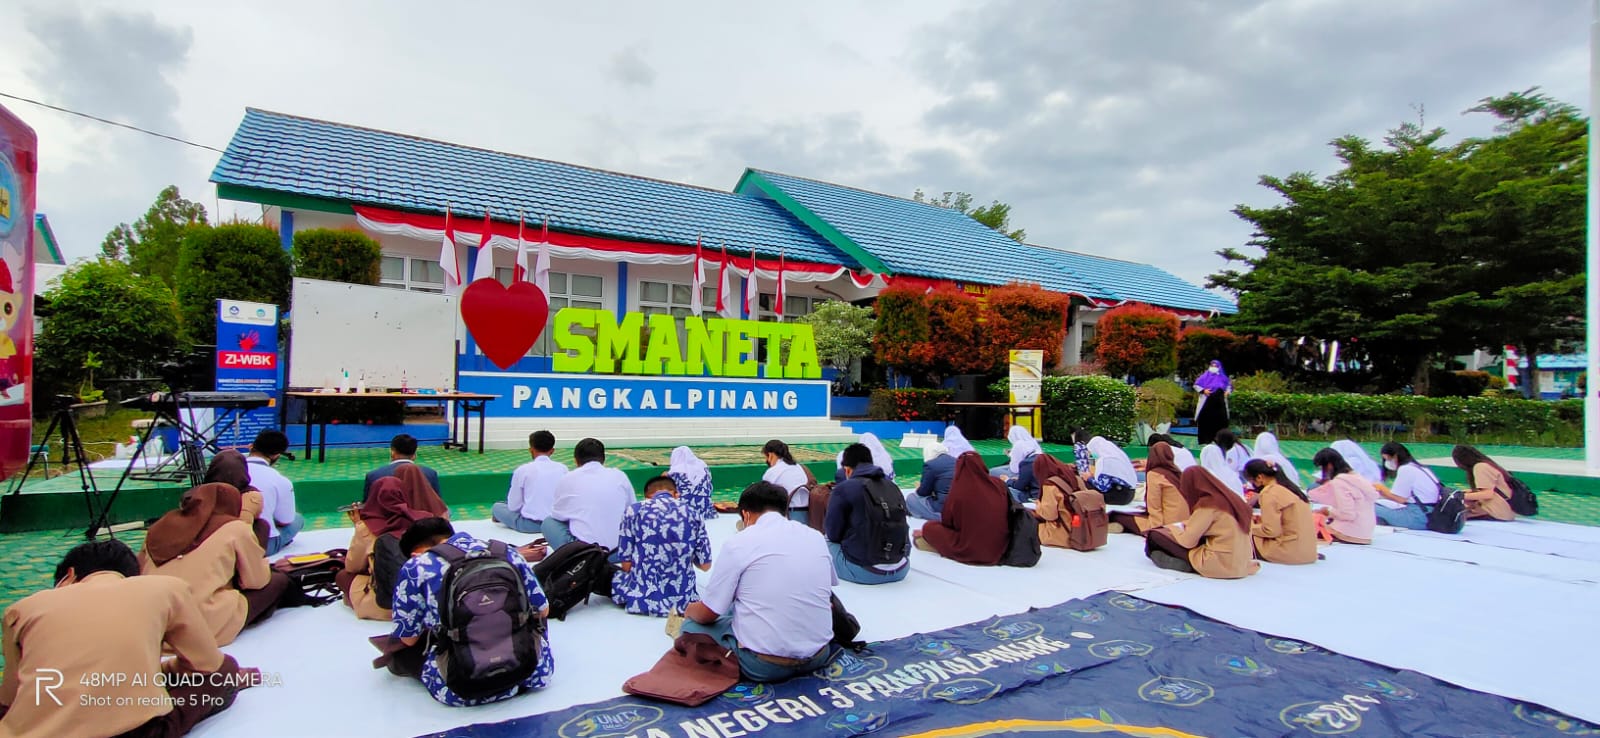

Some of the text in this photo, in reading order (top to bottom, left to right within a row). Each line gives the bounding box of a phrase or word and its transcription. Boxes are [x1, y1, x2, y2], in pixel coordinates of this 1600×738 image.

[964, 284, 980, 294] SMA
[552, 307, 822, 378] SMANETA
[225, 353, 271, 366] ZI-WBK
[513, 385, 798, 410] PANGKALPINANG
[679, 635, 1071, 738] NEGERI 3 PANGKALPINANG
[576, 717, 598, 737] 3
[595, 709, 640, 725] UNITY
